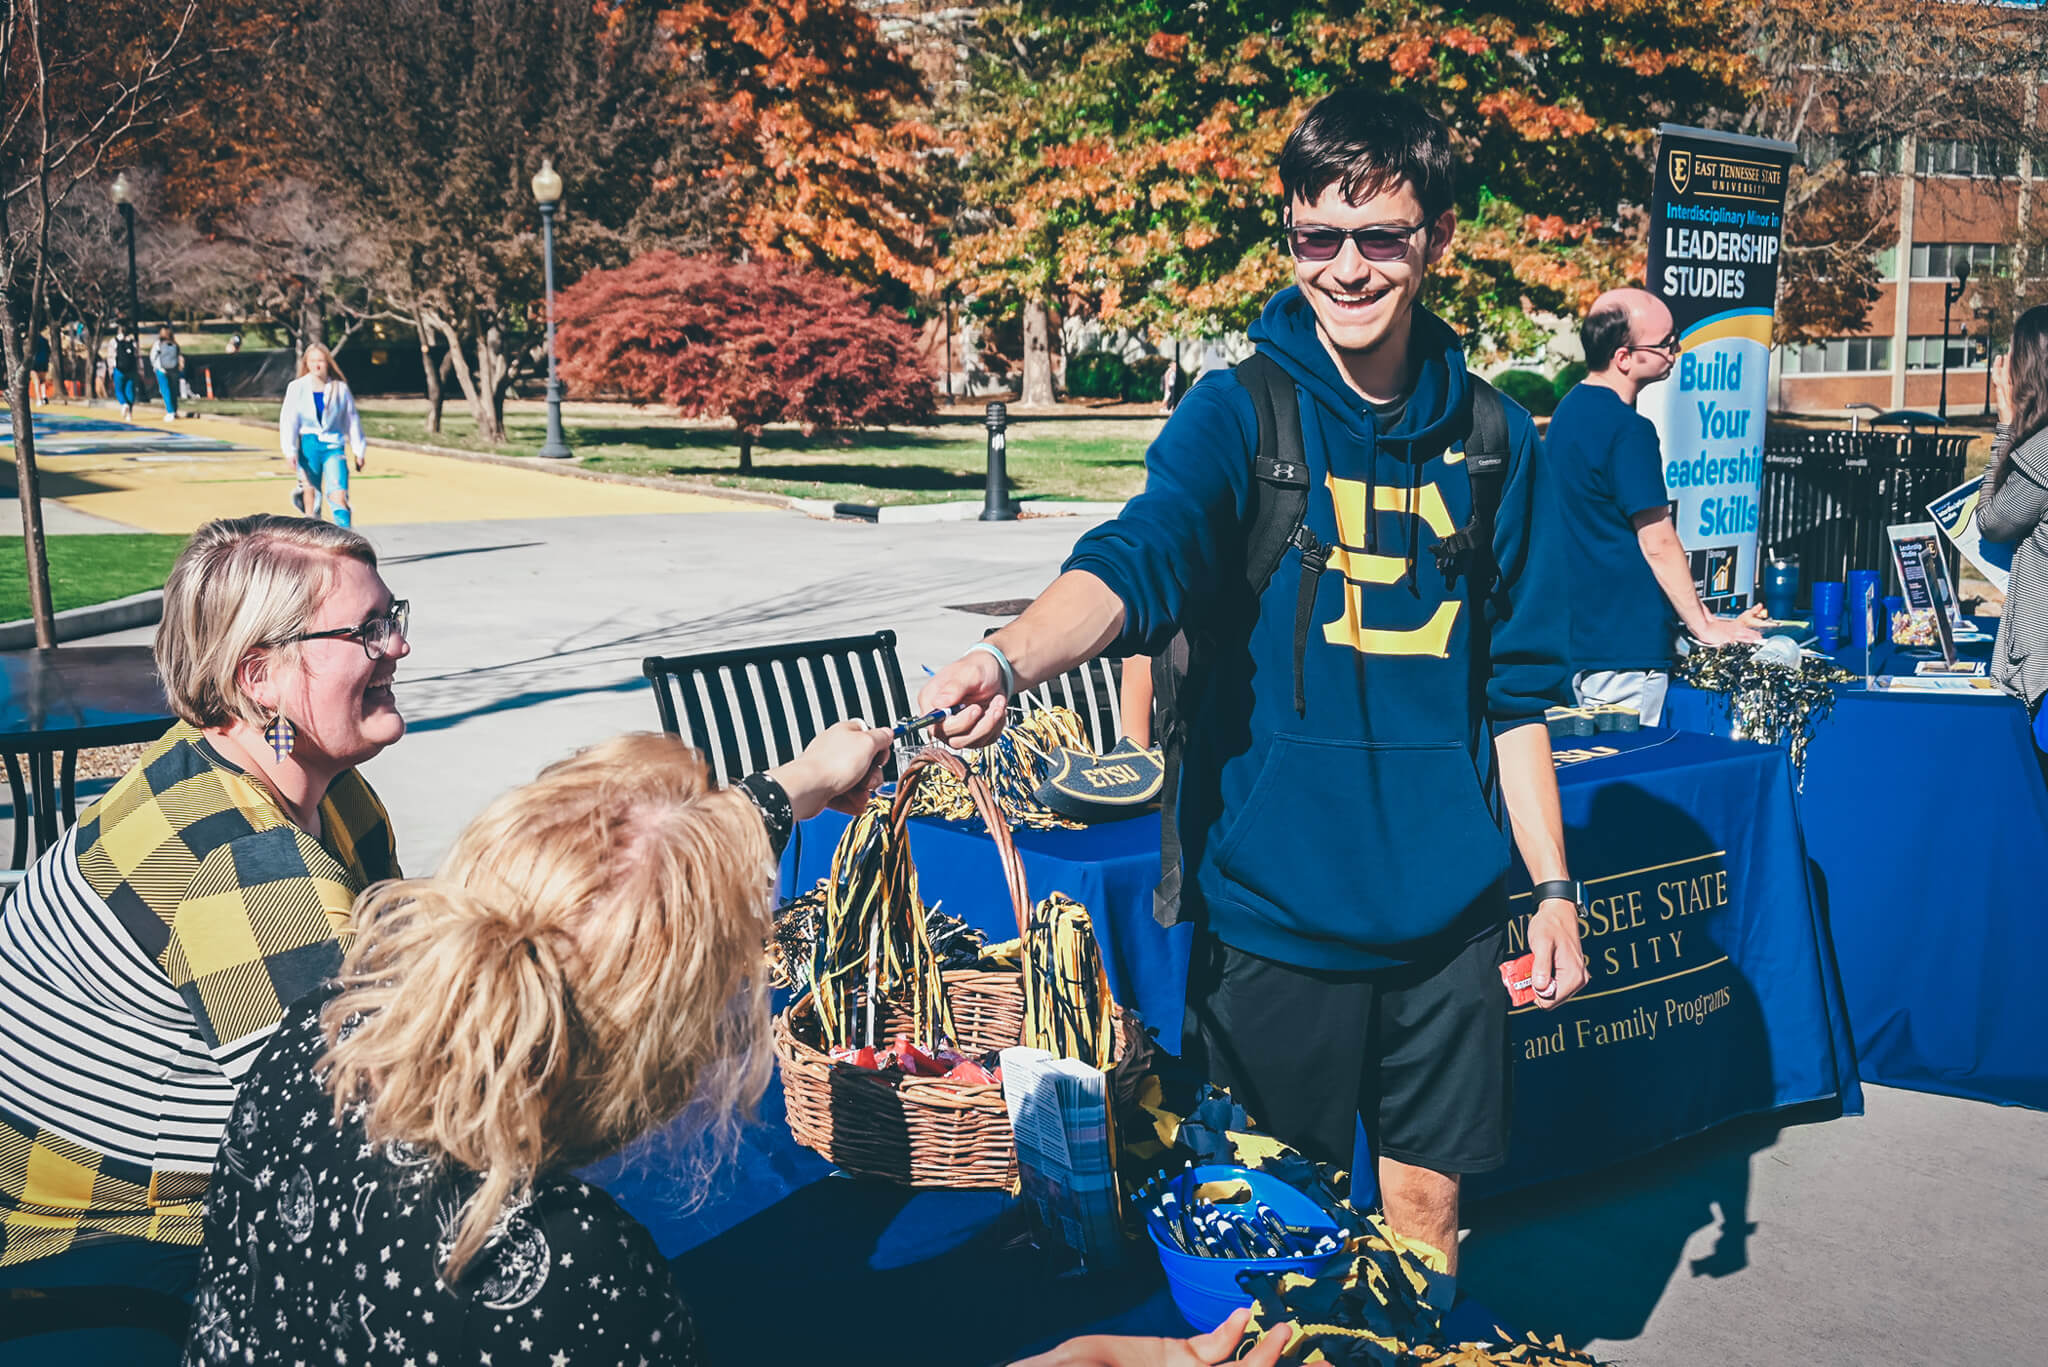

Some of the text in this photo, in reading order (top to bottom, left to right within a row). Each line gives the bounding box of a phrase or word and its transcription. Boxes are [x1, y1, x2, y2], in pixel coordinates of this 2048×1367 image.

[1695, 161, 1781, 184] EAST TENNESSEE STATE
[1712, 180, 1766, 195] UNIVERSITY
[1667, 202, 1780, 228] Interdisciplinary Minor in
[1666, 227, 1779, 264] LEADERSHIP
[1663, 265, 1745, 298] STUDIES
[1680, 352, 1742, 391] Build
[1698, 401, 1750, 439] Your
[1666, 446, 1763, 491] eadership
[1699, 496, 1759, 536] Skills
[1081, 763, 1141, 788] ETSU
[1656, 870, 1728, 920] STATE
[1524, 1024, 1565, 1059] and
[1575, 1006, 1658, 1048] Family
[1665, 985, 1730, 1026] Programs
